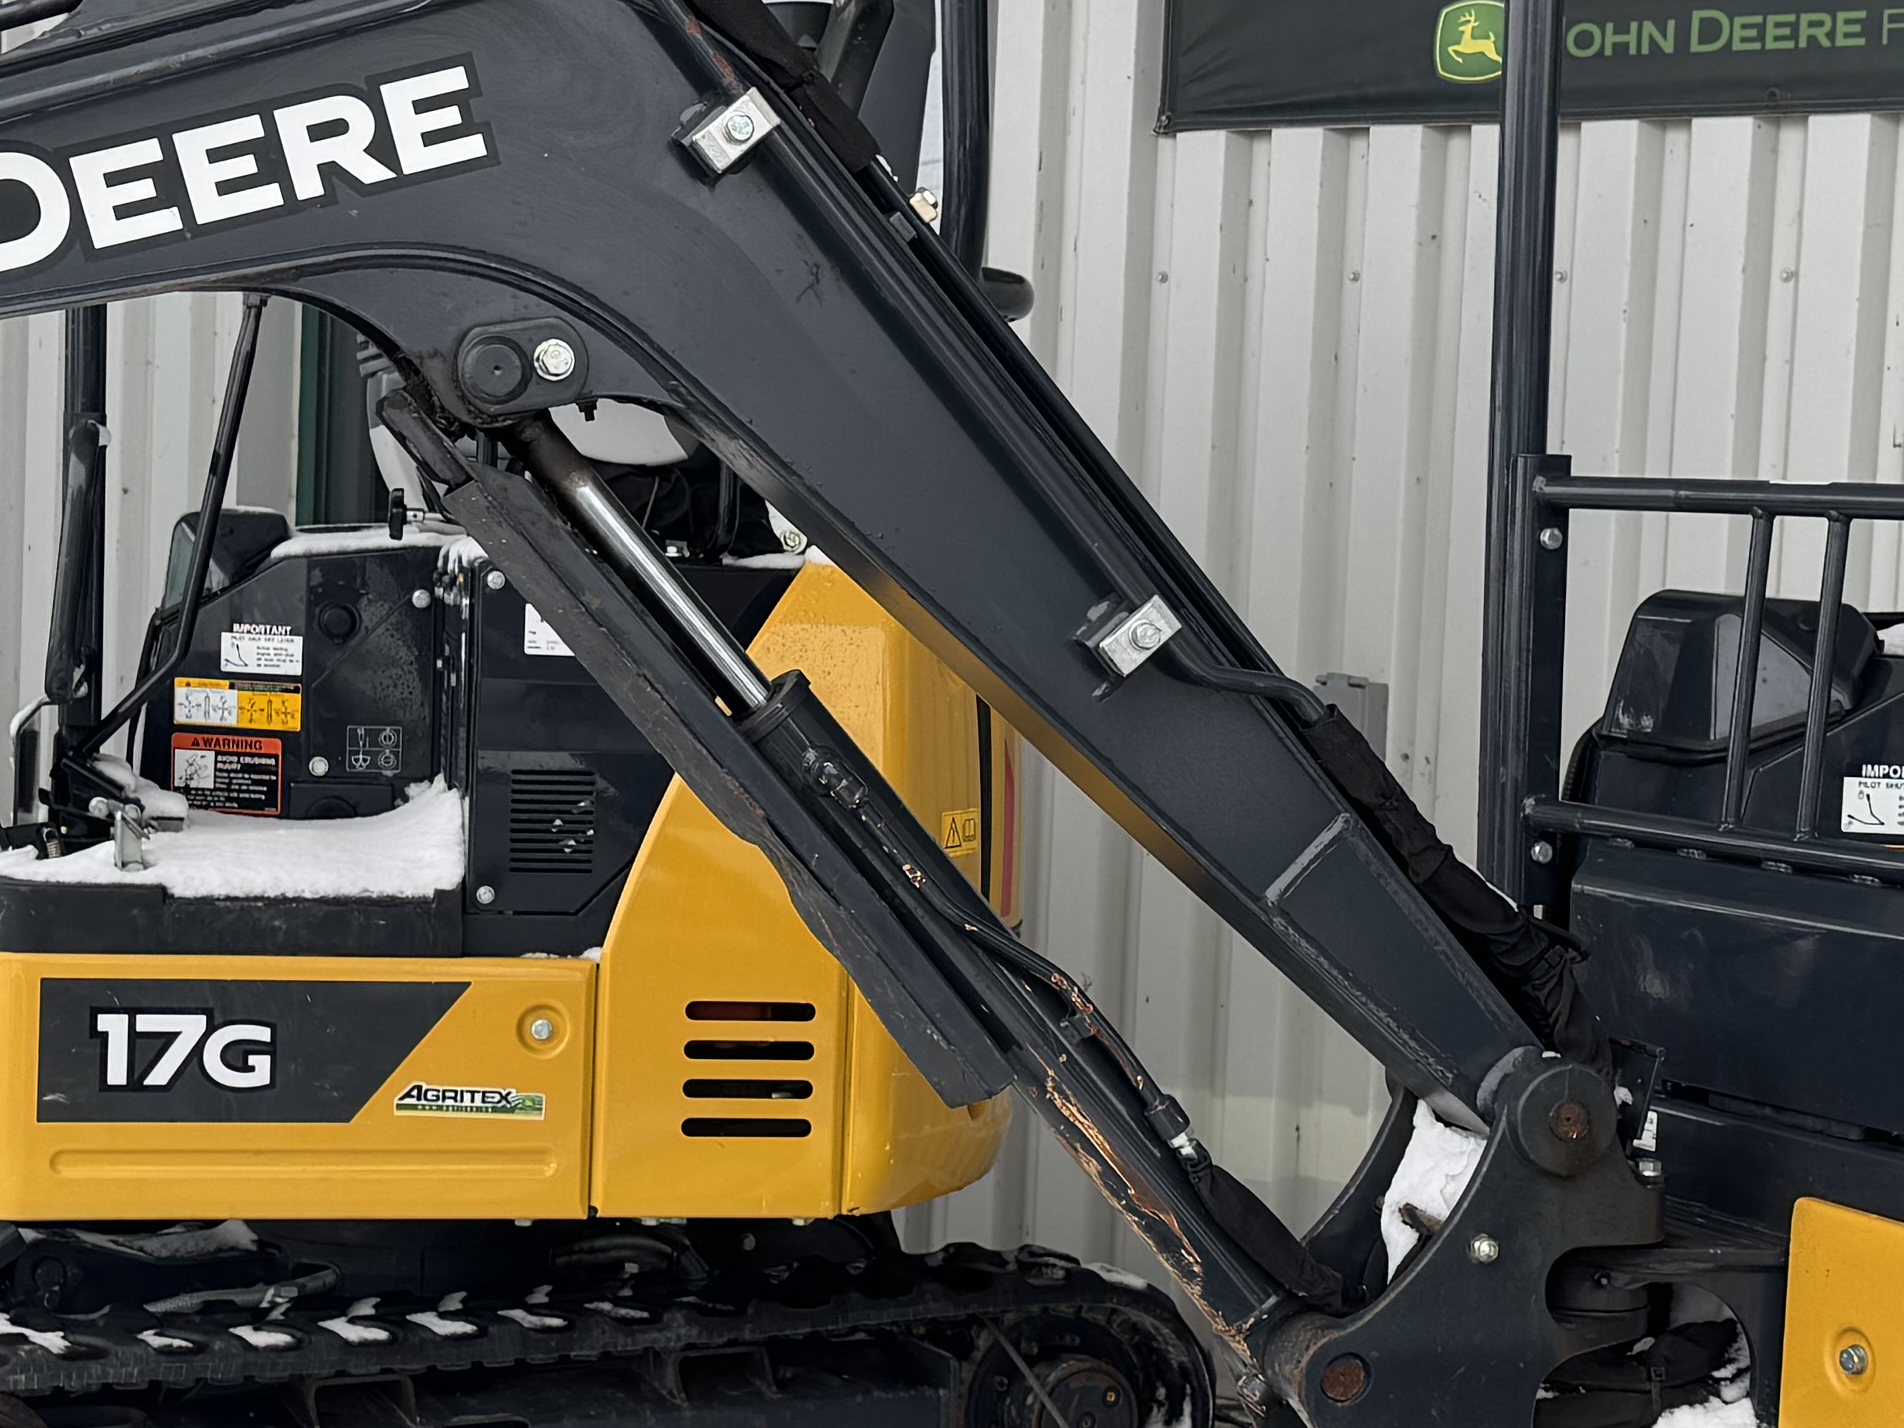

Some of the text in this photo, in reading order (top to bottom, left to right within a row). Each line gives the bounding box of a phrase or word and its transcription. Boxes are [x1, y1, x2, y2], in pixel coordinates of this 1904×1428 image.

[1566, 19, 1676, 58] OHN
[1689, 9, 1867, 53] DEERE
[233, 623, 292, 636] IMPORTANT
[202, 737, 263, 751] WARNING
[97, 1014, 272, 1088] 17G
[397, 1084, 514, 1107] AGRITEX
